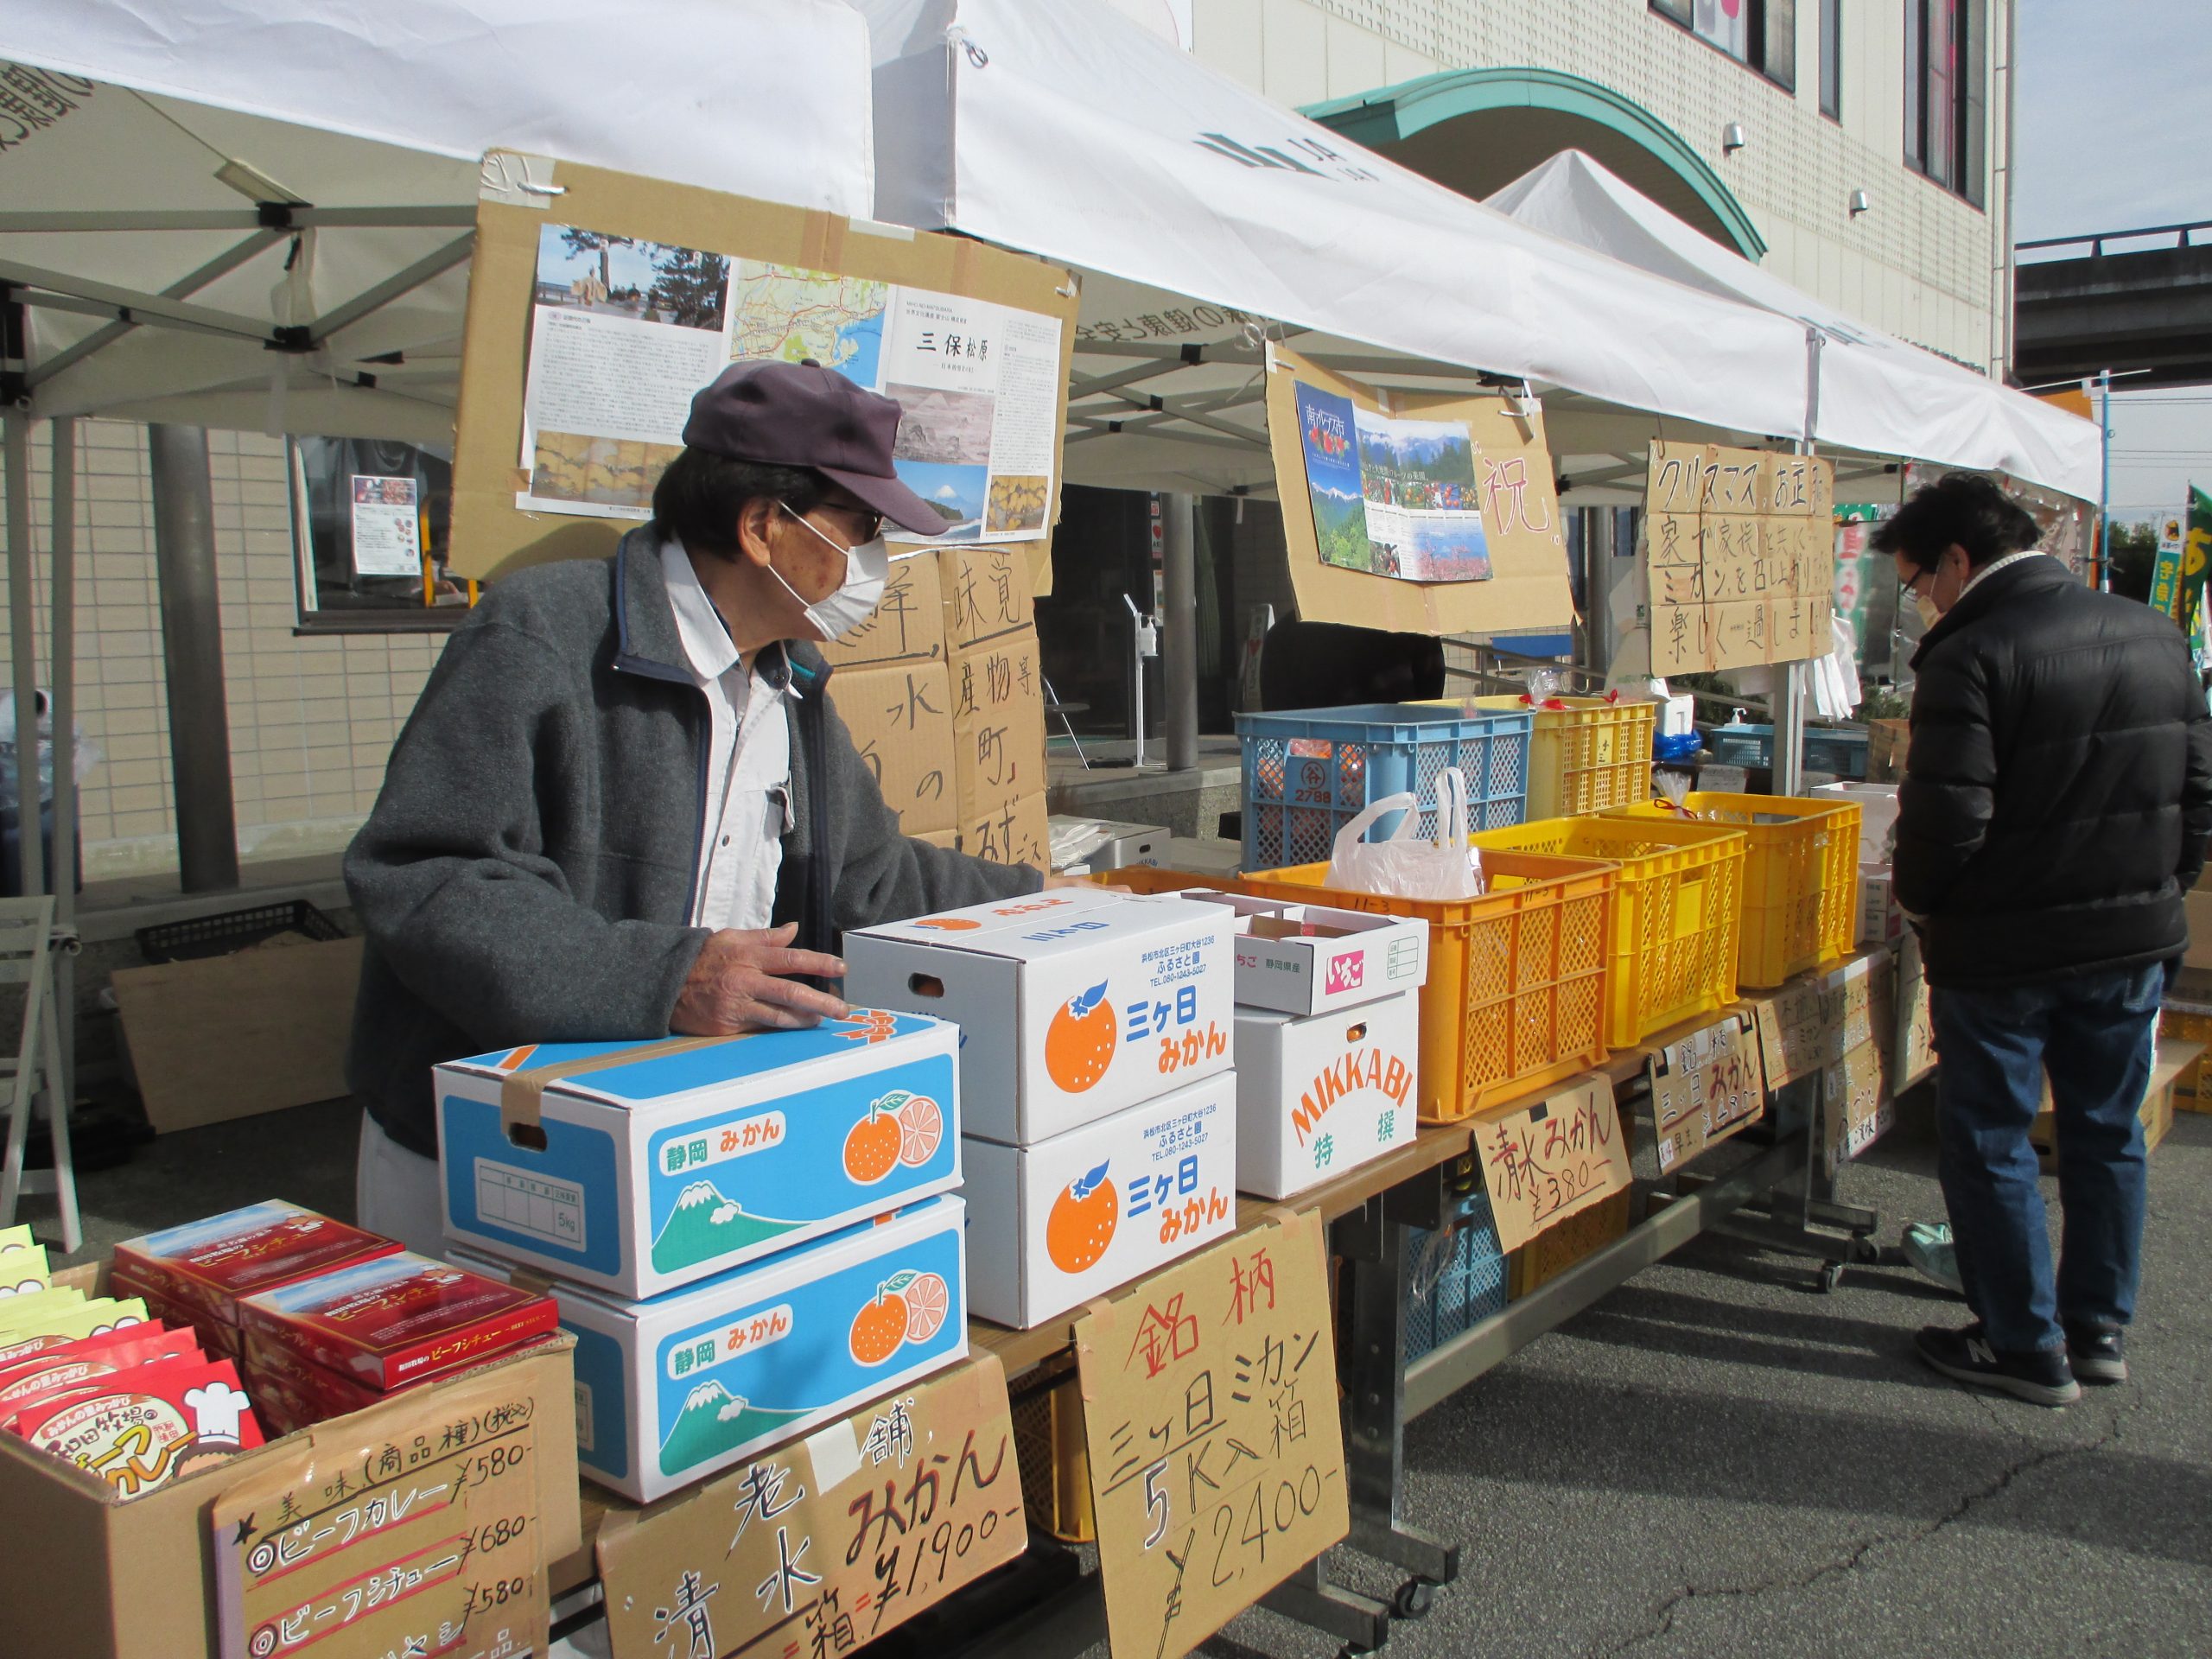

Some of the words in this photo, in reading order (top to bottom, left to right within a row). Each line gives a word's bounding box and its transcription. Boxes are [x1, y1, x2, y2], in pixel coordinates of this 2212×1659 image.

[917, 332, 988, 361] 三保松原
[954, 554, 1021, 640] 味覚
[1354, 898, 1390, 912] 11-3
[1150, 964, 1206, 988] TEL.080-1243-5027
[1265, 958, 1301, 973] 静岡県産
[1326, 957, 1364, 988] いちご
[1158, 1020, 1226, 1074] みかん
[1291, 1048, 1414, 1148] MIKKABI
[666, 1138, 708, 1172] 静岡
[720, 1118, 780, 1153] みかん
[1152, 1133, 1208, 1162] TEL.080-1243-5027
[1160, 1186, 1228, 1244] みかん
[1124, 1247, 1276, 1381] 銘柄
[430, 1329, 503, 1362] ビーフシチュー
[674, 1339, 715, 1376] 静岡
[728, 1312, 788, 1351] みかん
[1966, 1338, 1998, 1363] N
